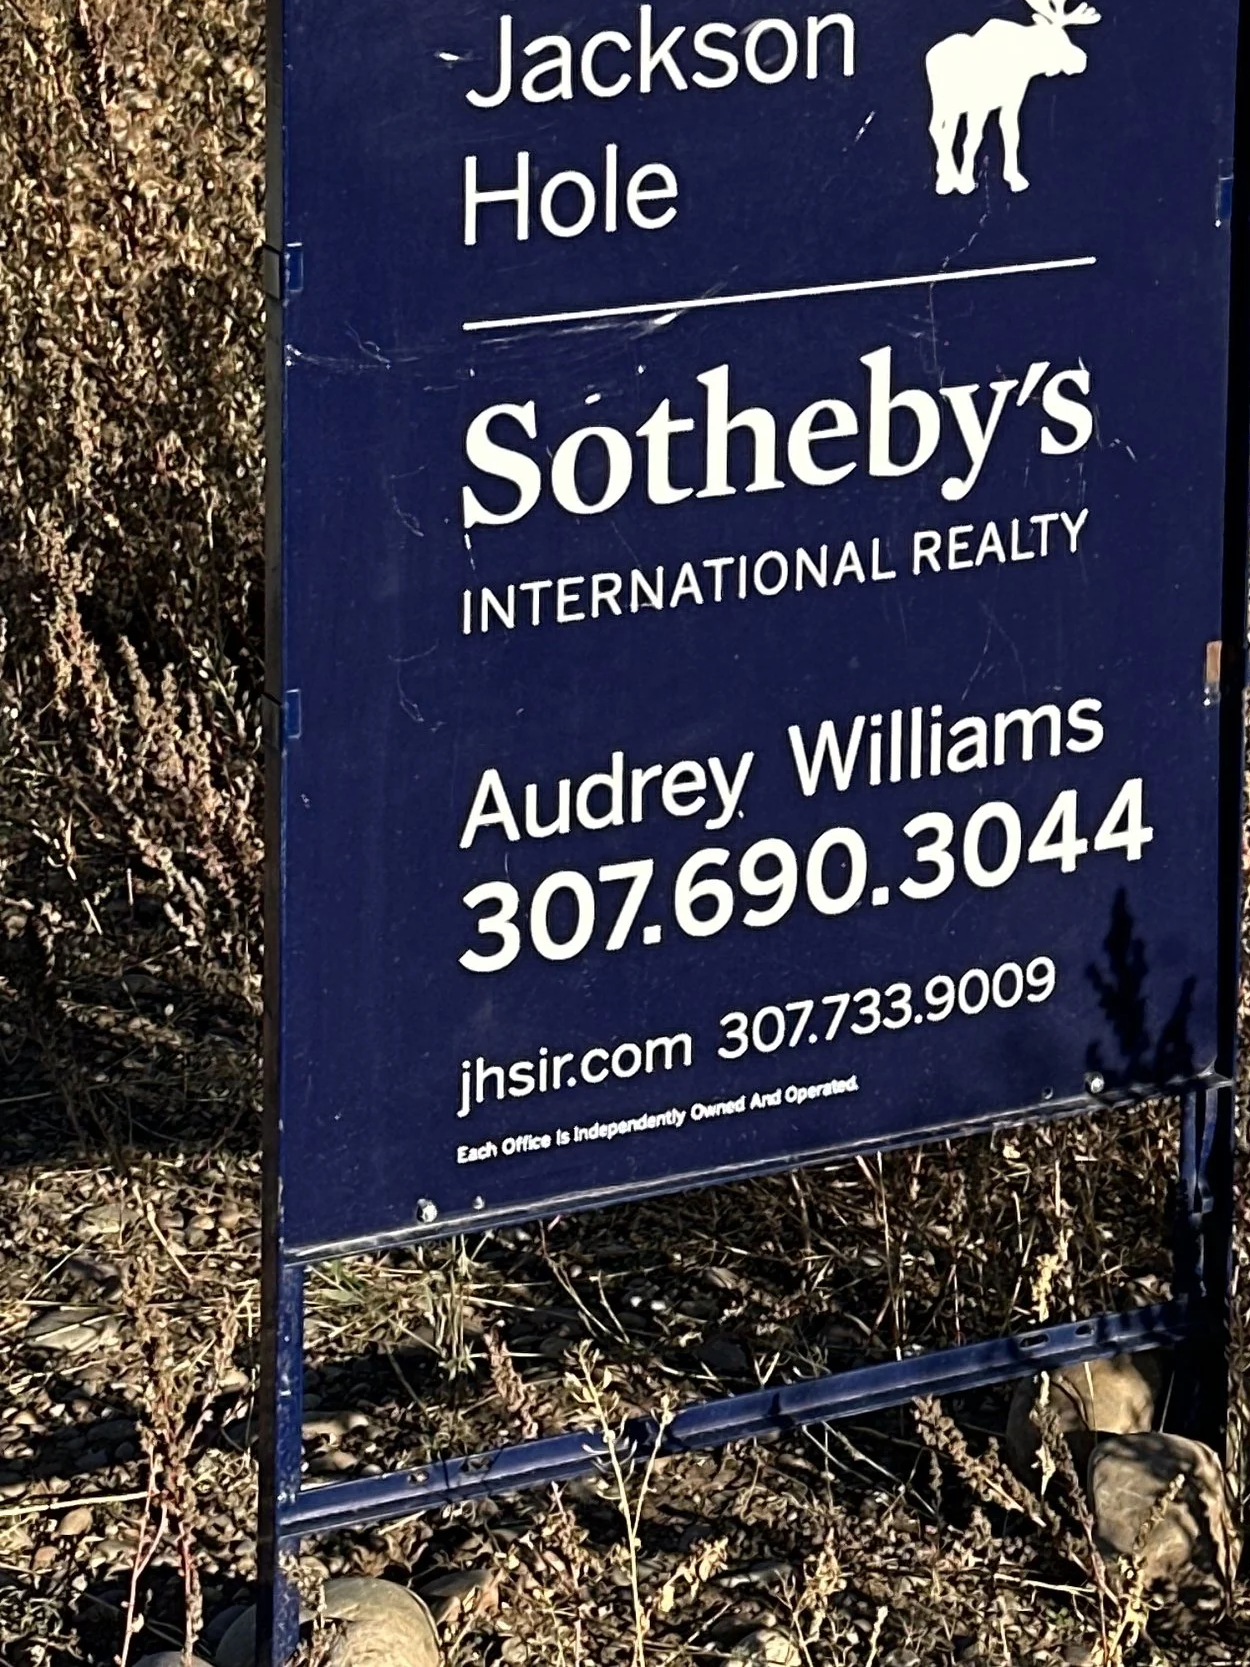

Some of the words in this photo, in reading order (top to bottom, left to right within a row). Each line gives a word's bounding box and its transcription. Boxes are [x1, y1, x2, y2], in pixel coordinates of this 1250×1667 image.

[466, 4, 854, 107] Jackson
[465, 144, 677, 245] Hole
[463, 346, 1092, 528] Sotheby's
[463, 537, 896, 634] INTERNATIONAL
[913, 508, 1088, 575] REALTY
[460, 751, 754, 848] Audrey
[788, 698, 1103, 796] Williams
[459, 777, 1153, 972] 307.690.3044
[457, 1033, 691, 1117] jhsir.com
[718, 957, 1055, 1058] 307.733.9009
[457, 1141, 497, 1163] Each
[502, 1133, 551, 1156] Office
[556, 1129, 570, 1145] Is
[574, 1108, 686, 1142] Independently
[691, 1095, 745, 1120] Owned
[750, 1089, 781, 1109] And
[785, 1075, 859, 1104] Operated.
